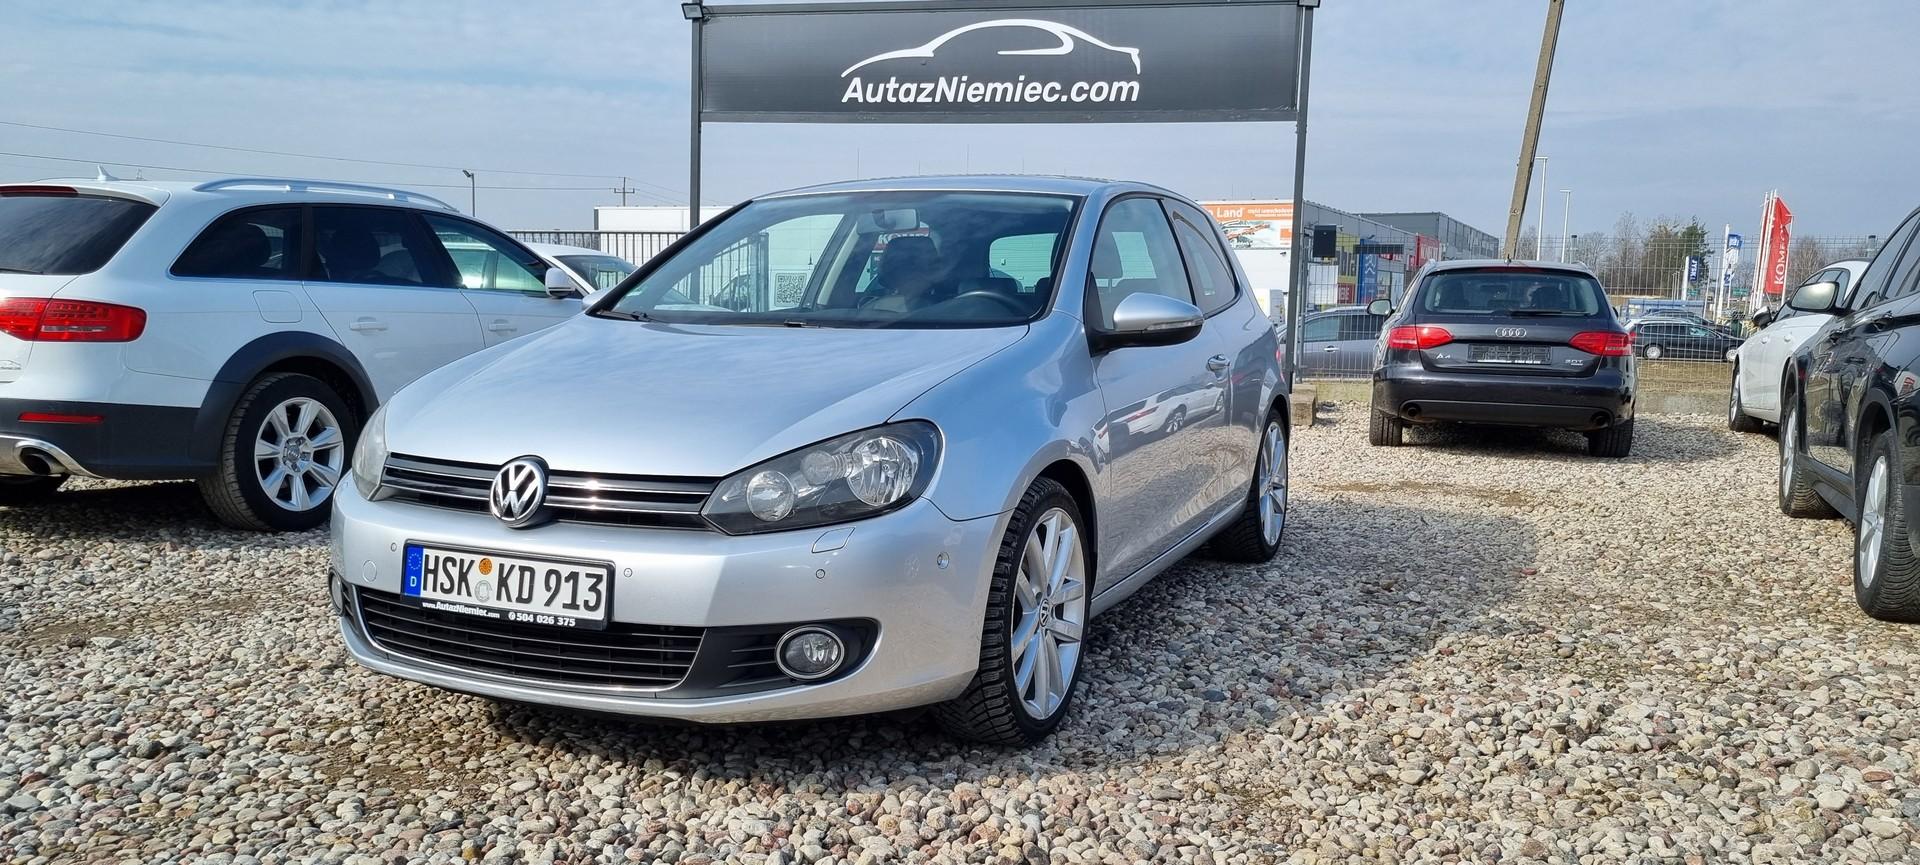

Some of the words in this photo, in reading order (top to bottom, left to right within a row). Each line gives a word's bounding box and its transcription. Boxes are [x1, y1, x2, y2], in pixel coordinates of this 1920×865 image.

[841, 75, 1140, 103] AutazNiemiec.com
[410, 576, 417, 587] D
[422, 554, 475, 597] HSK
[496, 563, 535, 604] KD
[543, 568, 604, 613] 913
[516, 613, 534, 622] 504
[536, 616, 555, 625] 026
[557, 617, 576, 627] 375
